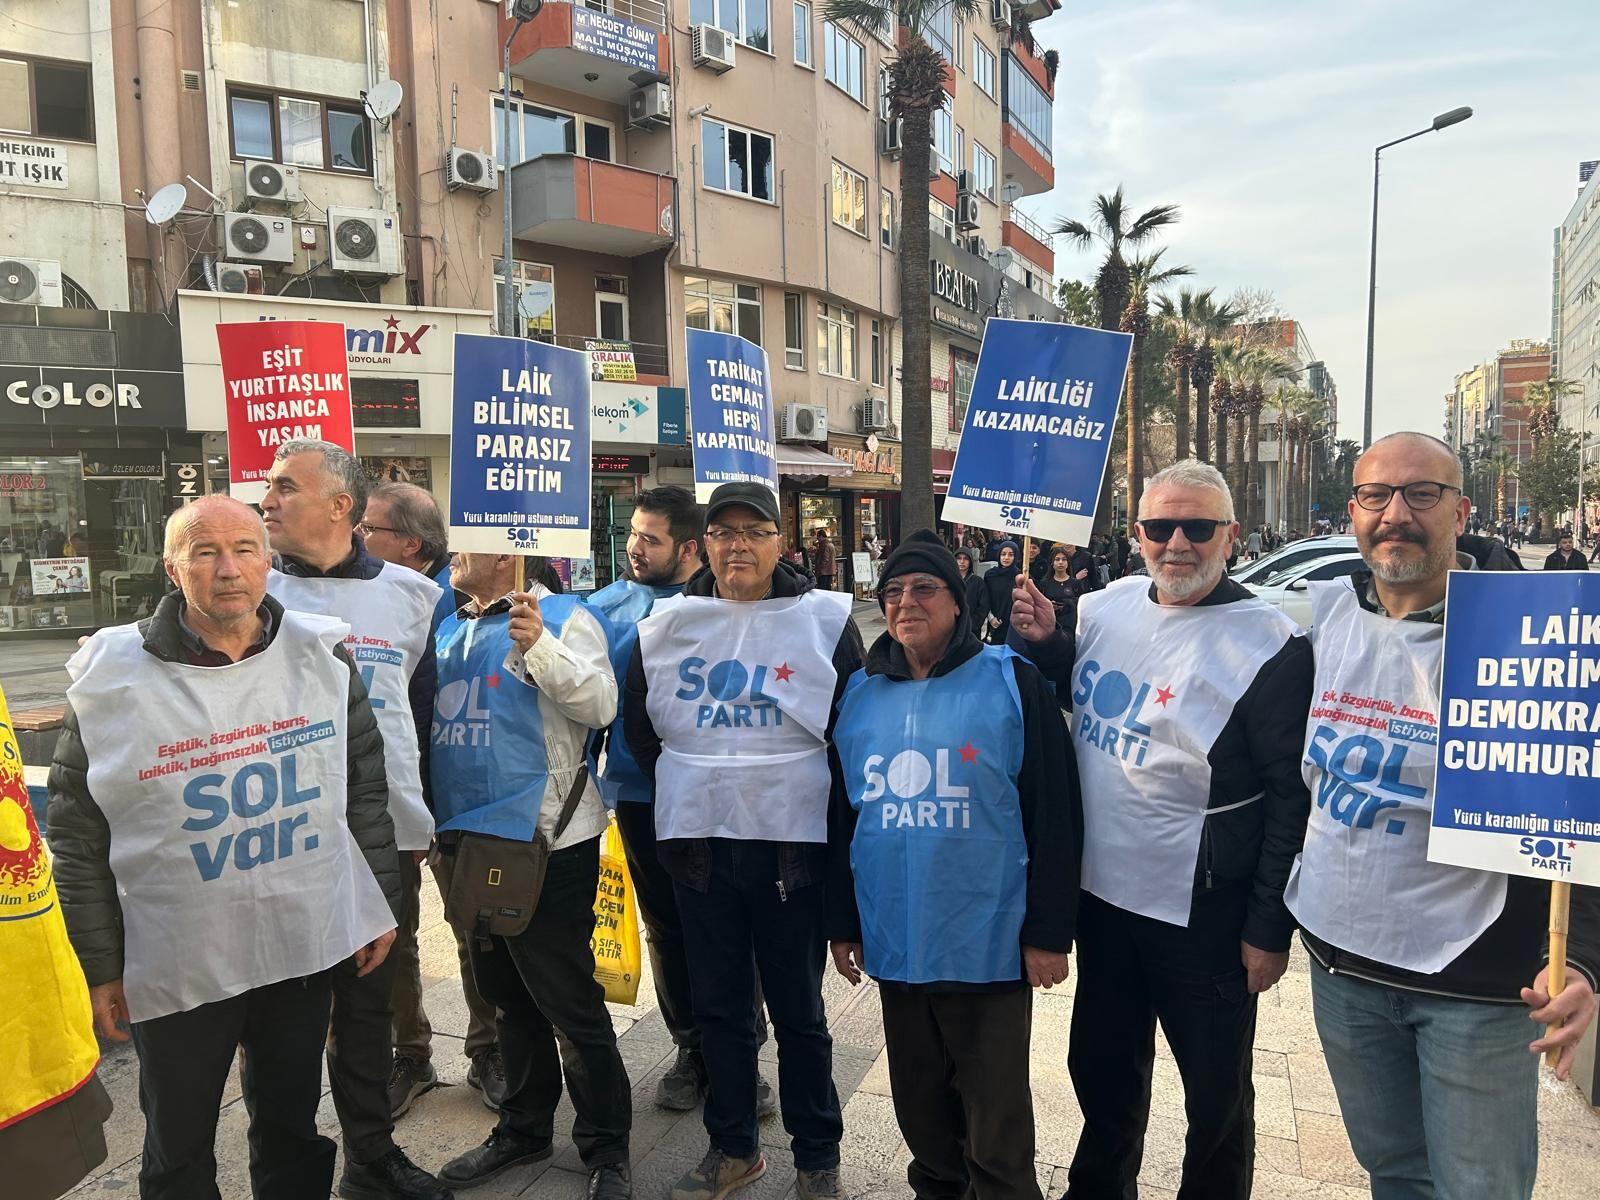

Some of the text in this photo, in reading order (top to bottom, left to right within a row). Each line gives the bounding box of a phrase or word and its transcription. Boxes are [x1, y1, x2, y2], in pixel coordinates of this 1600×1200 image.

[590, 14, 624, 35] NECDET
[627, 25, 656, 45] GÜNAY
[606, 40, 656, 63] MÜŞAVİR
[24, 162, 63, 183] IŞIK
[262, 345, 303, 372] EŞİT
[707, 358, 763, 387] TARİKAT
[6, 380, 142, 409] COLOR
[229, 373, 344, 398] YURTTAŞLIK
[502, 366, 552, 396] LAİK
[997, 376, 1094, 408] LAİKLİĞİ
[247, 398, 330, 422] İNSANCA
[592, 405, 629, 418] lekom
[711, 384, 764, 410] CEMAAT
[474, 396, 574, 430] BİLİMSEL
[723, 409, 761, 432] HEPSİ
[972, 409, 1105, 441] KAZANACAĞIZ
[476, 434, 571, 462] PARASIZ
[697, 432, 776, 460] KAPATILACAK
[0, 474, 46, 489] LOR 2
[135, 465, 154, 473] COLOR
[486, 462, 562, 493] EĞİTİM
[981, 488, 1022, 504] karanlığın
[1000, 506, 1031, 521] SOL
[507, 528, 538, 542] SOL
[1521, 607, 1600, 645] LAİK
[675, 657, 780, 705] SOL
[1477, 651, 1600, 688] DEVRİM
[434, 676, 490, 720] OL
[1072, 659, 1152, 736] SOL
[1340, 692, 1397, 716] özgürlük,
[158, 715, 310, 759] Eşitlik, özgürlük, barış,
[1324, 708, 1388, 731] ağımsızlık
[1390, 721, 1438, 742] istiyor
[138, 725, 333, 781] laiklik, bağımsızlık istiyorsan
[1308, 725, 1428, 799] SOL
[1444, 739, 1600, 778] CUMHURİ
[861, 749, 970, 802] SOL
[181, 753, 321, 832] SOL
[1318, 767, 1406, 836] var.
[1454, 809, 1600, 836] Yürü karanlığın üstüne
[190, 812, 319, 882] var.
[1519, 837, 1572, 861] SOL
[597, 948, 622, 961] ATIK
[599, 938, 622, 952] SIFIR
